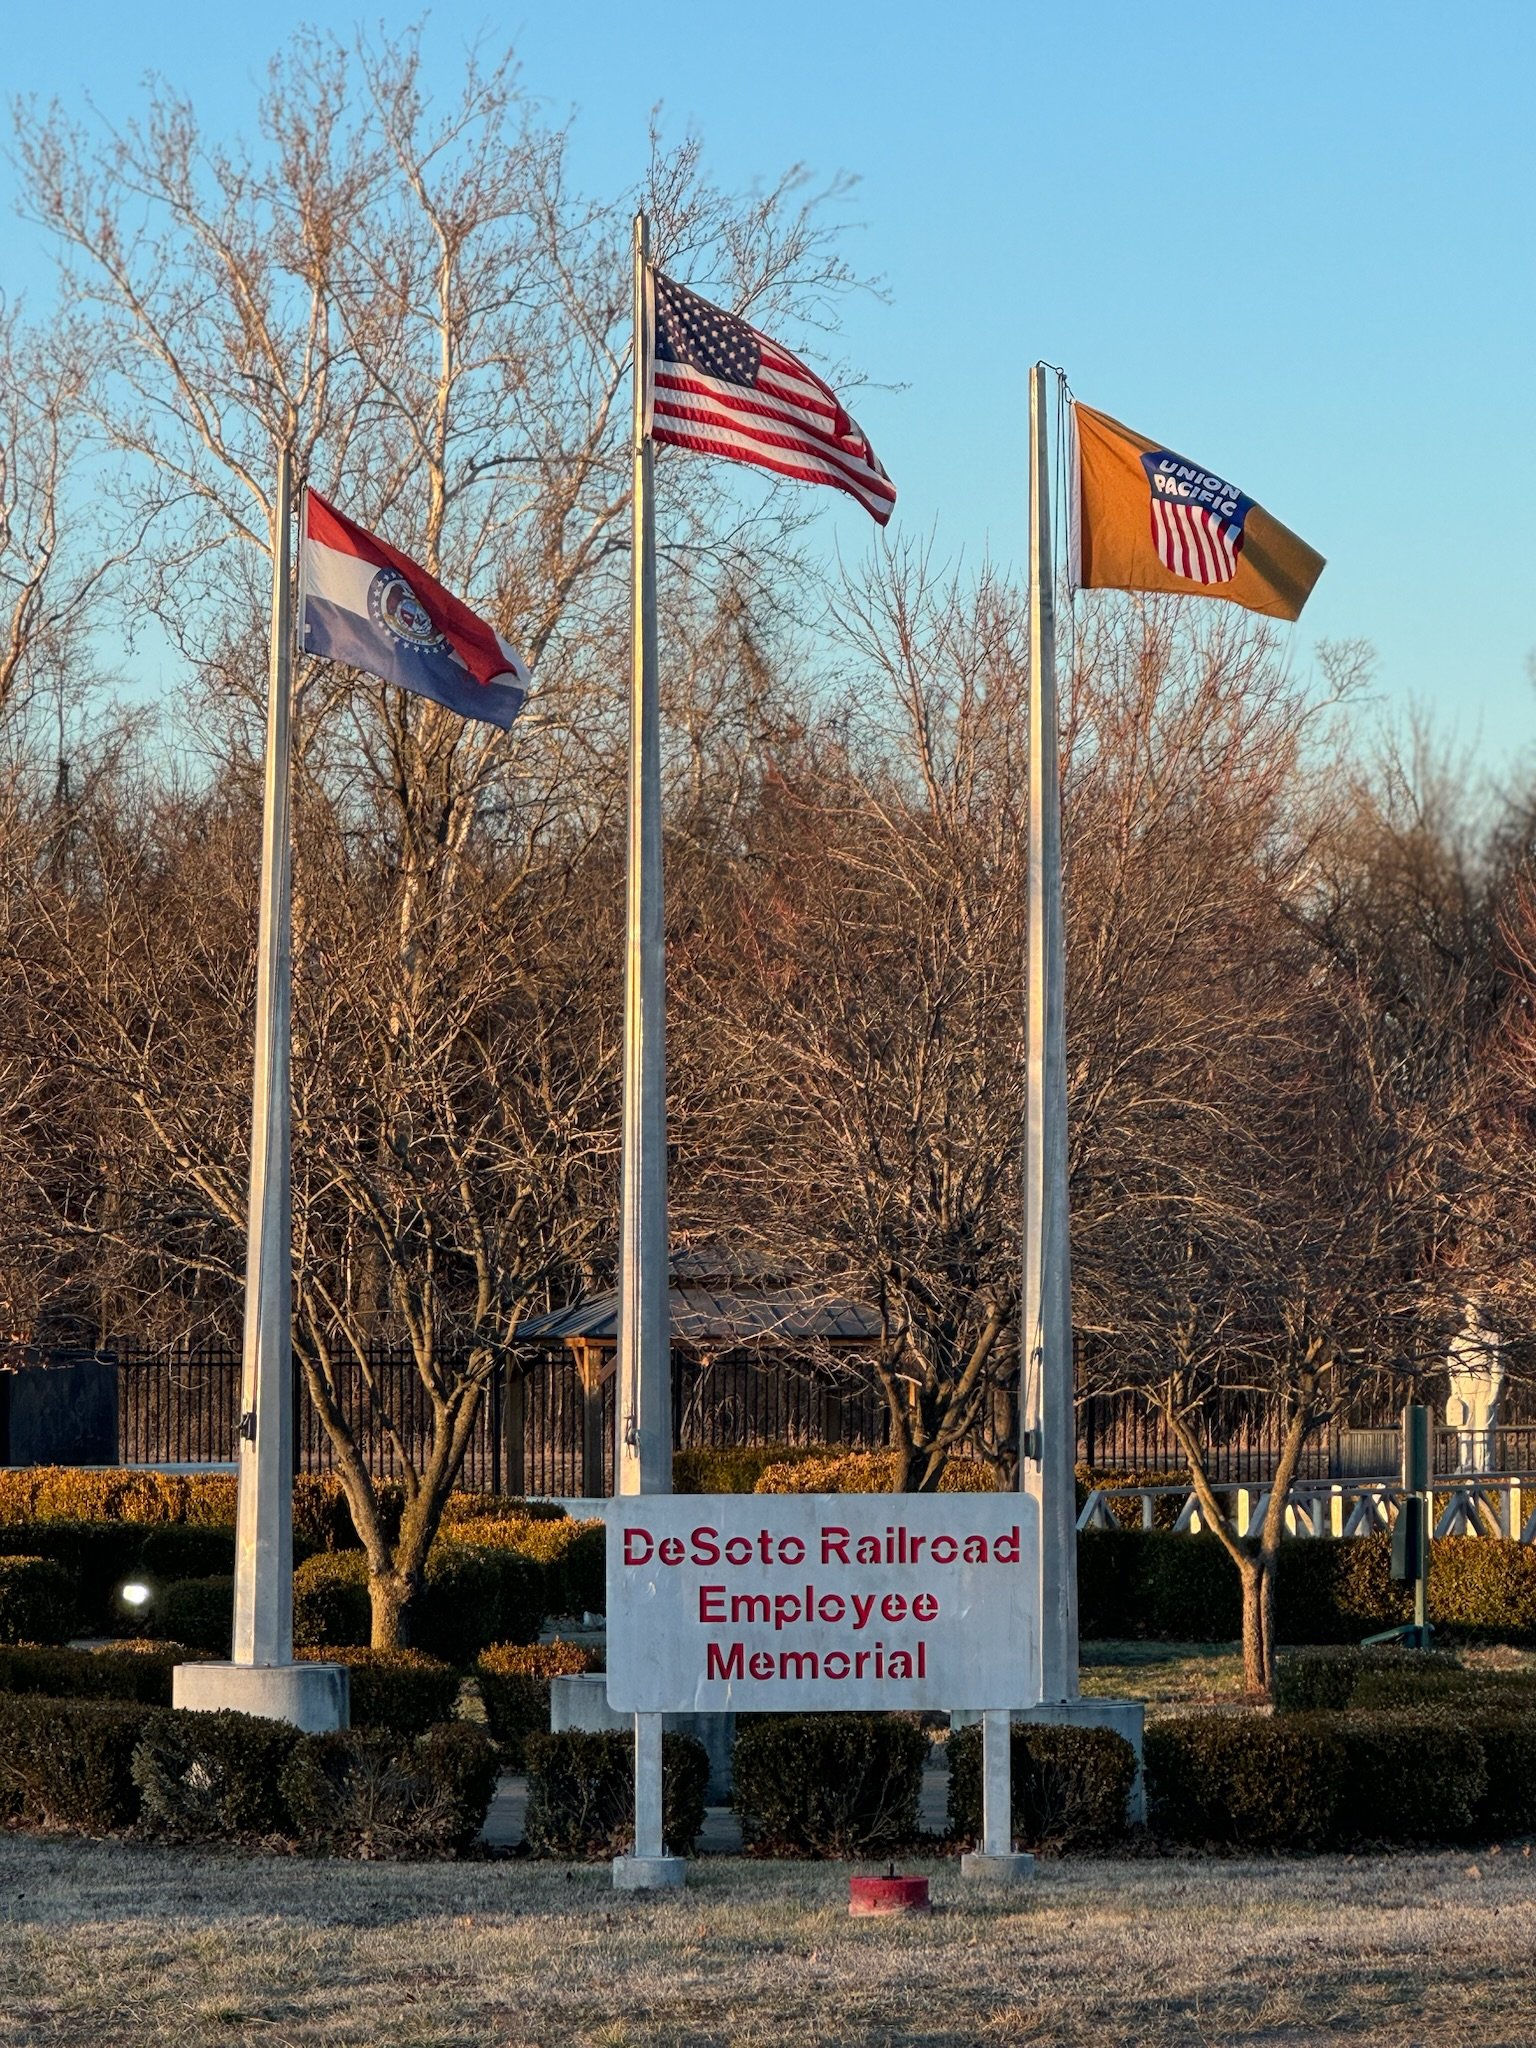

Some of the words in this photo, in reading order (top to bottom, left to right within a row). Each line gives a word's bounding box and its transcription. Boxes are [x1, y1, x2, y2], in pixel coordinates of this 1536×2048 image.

[1153, 473, 1238, 517] PACIFIC
[1159, 459, 1241, 500] UNION
[623, 1527, 806, 1566] DeSoto
[821, 1526, 1021, 1564] Railroad
[700, 1585, 939, 1630] Employee
[707, 1641, 926, 1680] Memorial
